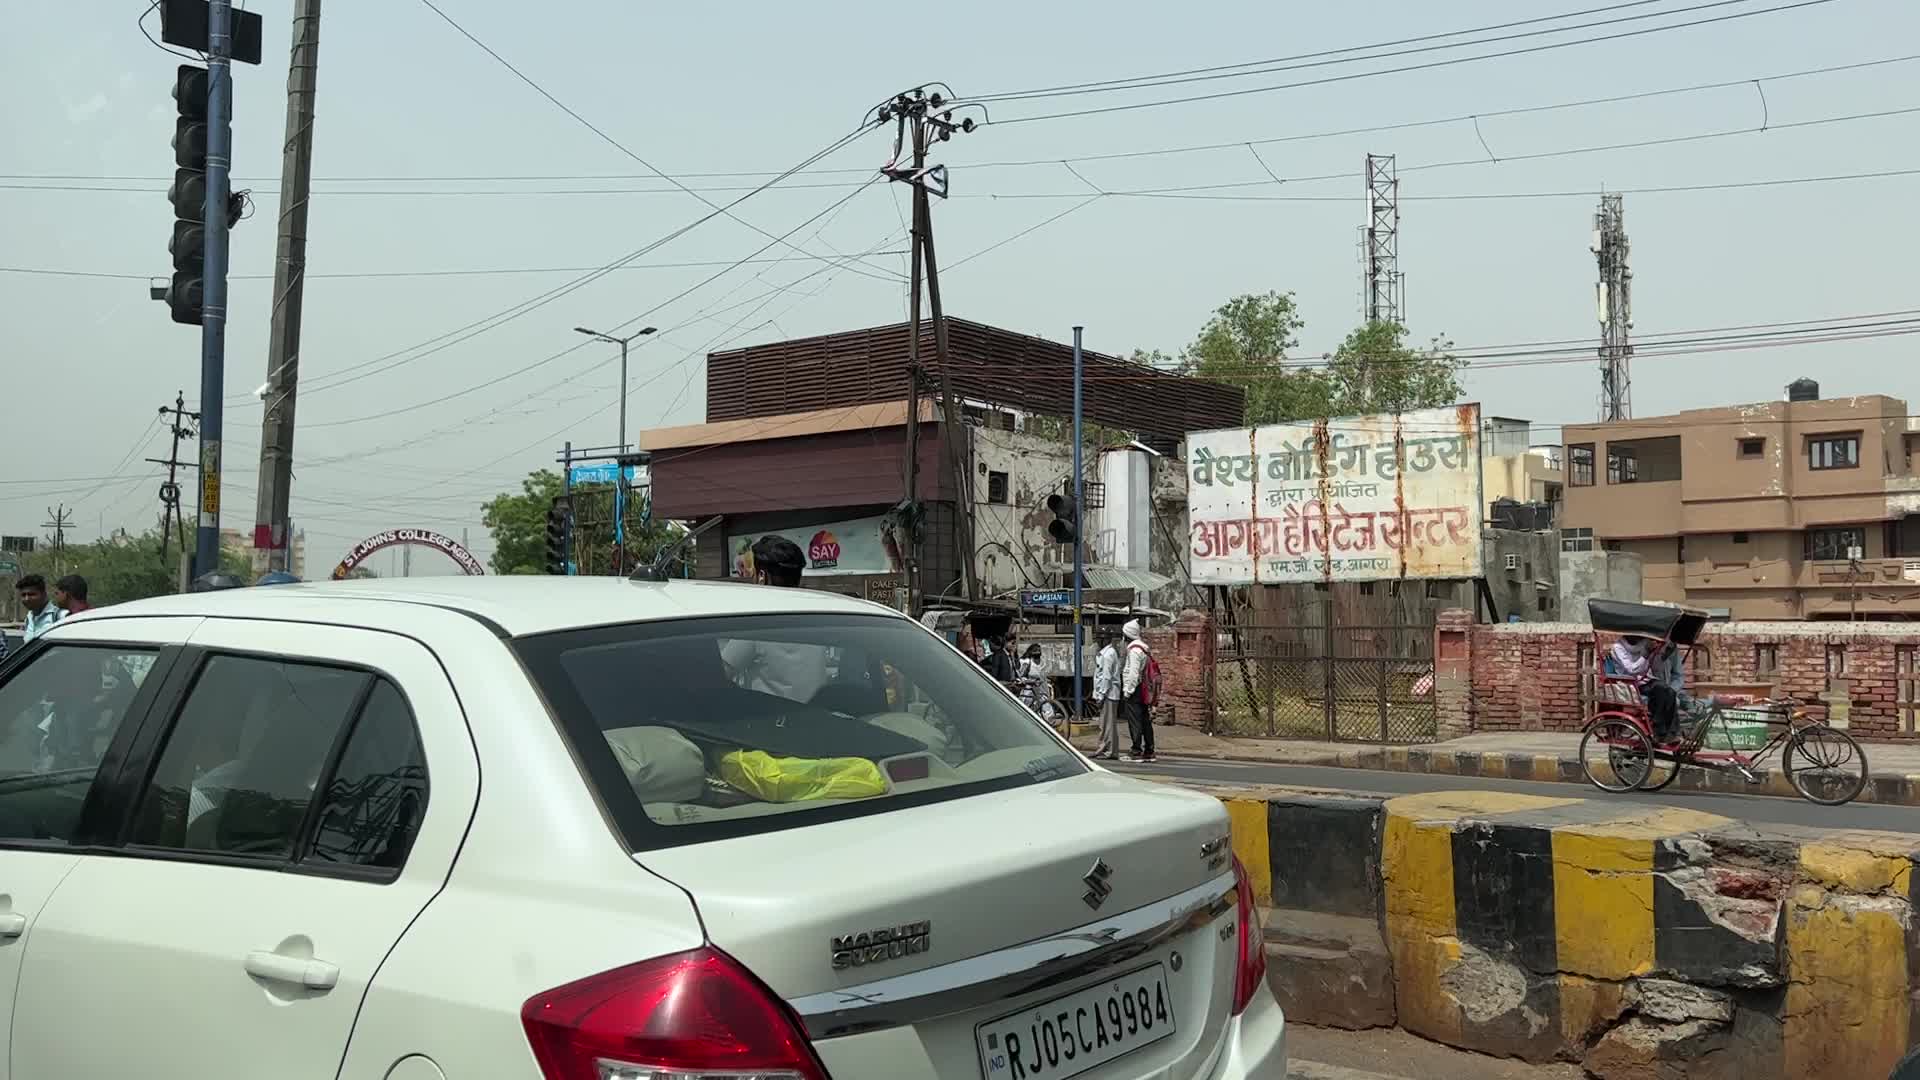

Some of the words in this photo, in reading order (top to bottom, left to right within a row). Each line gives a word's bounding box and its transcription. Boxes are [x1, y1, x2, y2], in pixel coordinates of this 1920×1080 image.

[1193, 446, 1260, 487] वैश्य
[399, 530, 451, 549] COLLEGE
[811, 543, 837, 561] SAY
[830, 920, 931, 951] MARUTI
[831, 935, 931, 970] SUZUKI
[1004, 980, 1168, 1080] RJ05CA9984
